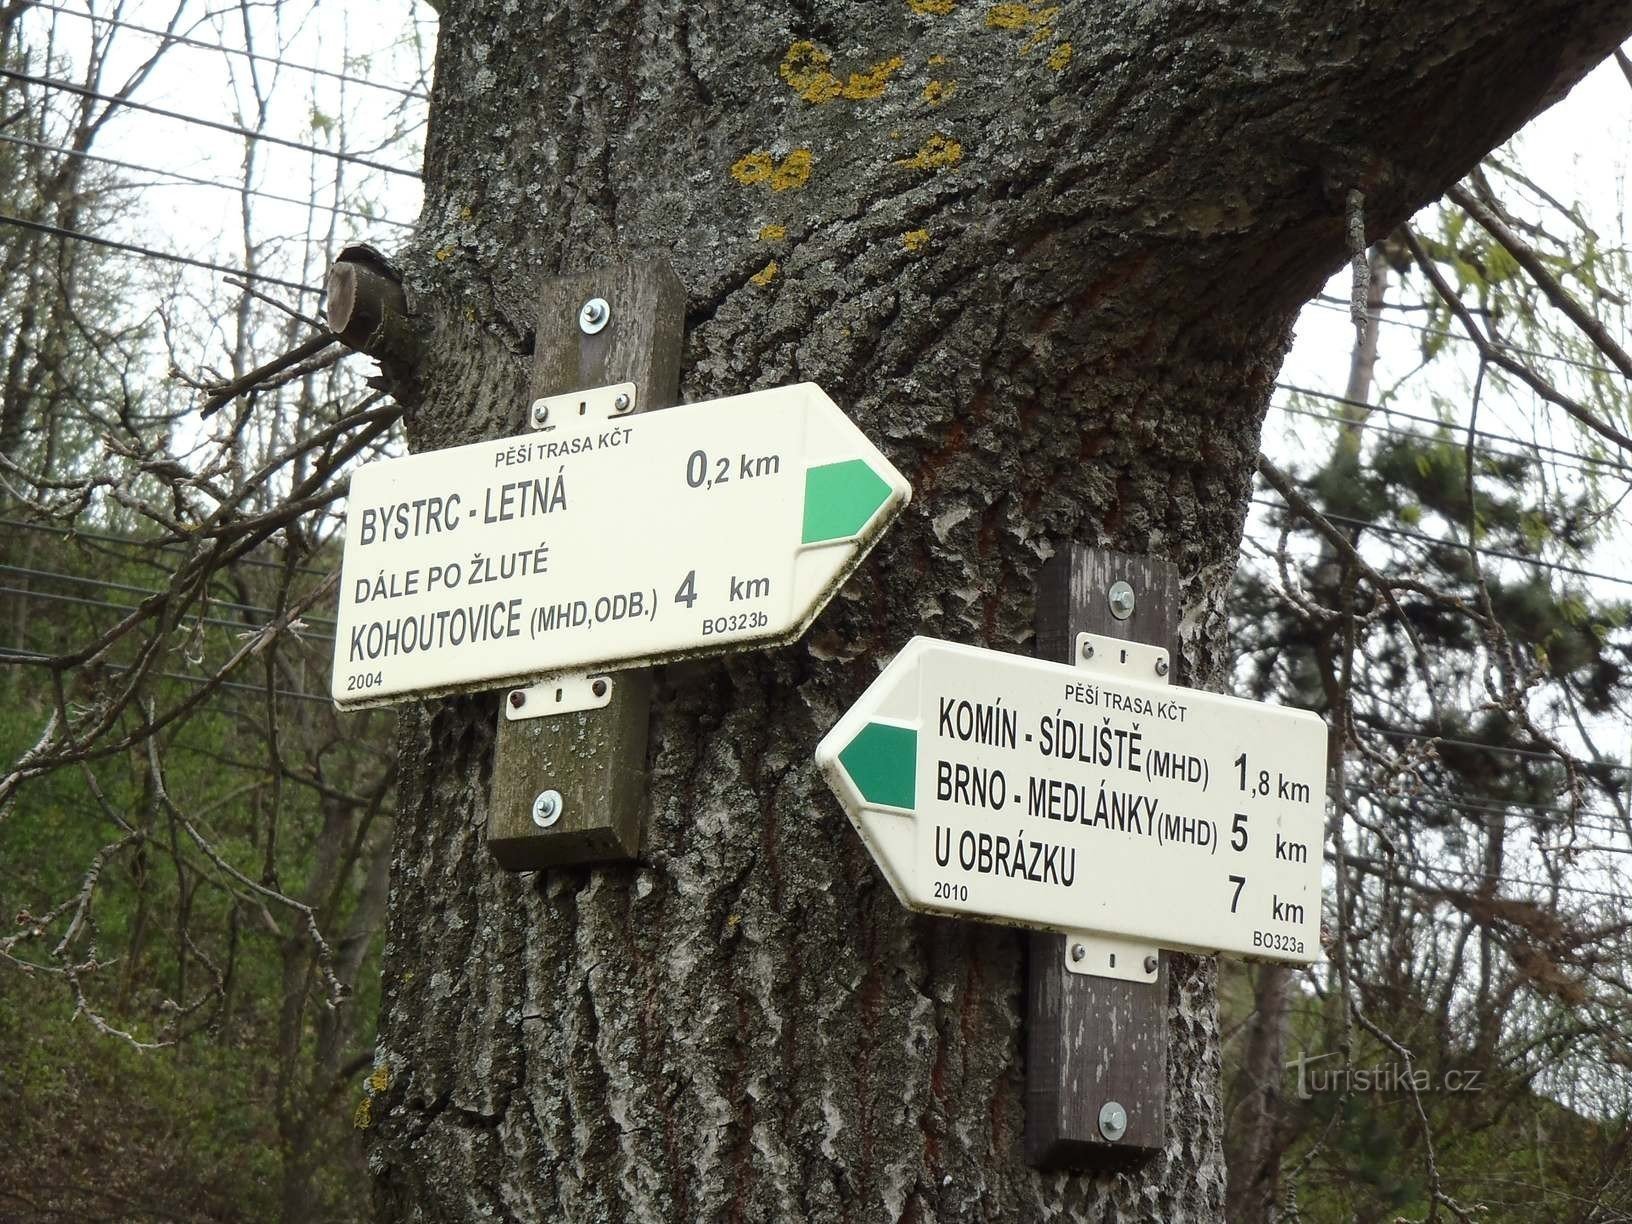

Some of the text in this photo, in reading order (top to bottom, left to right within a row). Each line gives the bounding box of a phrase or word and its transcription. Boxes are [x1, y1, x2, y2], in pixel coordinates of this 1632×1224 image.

[495, 427, 633, 468] PĚŠÍ TRASA KČT
[360, 493, 461, 546] BYSTRC
[483, 464, 567, 525] LETNÁ
[686, 449, 730, 491] 0,2
[739, 453, 780, 480] km
[354, 541, 549, 604] DÁLE PO ŽLUTÉ
[349, 570, 770, 663] KOHOUTOVICE (MHD,ODB.) 4 km
[702, 610, 768, 636] BO323b
[347, 671, 383, 691] 2004
[1064, 681, 1188, 723] PĚŠÍ TRASA KČT
[939, 696, 1017, 750] KOMÍN
[1234, 752, 1270, 799] 1,8
[1277, 772, 1310, 804] km
[936, 759, 1006, 811] BRNO
[1230, 812, 1249, 853] 5
[1275, 833, 1307, 864] km
[933, 881, 968, 902] 2010
[935, 825, 1304, 925] U OBRÁZKU 7 km
[1253, 930, 1304, 954] BO323a
